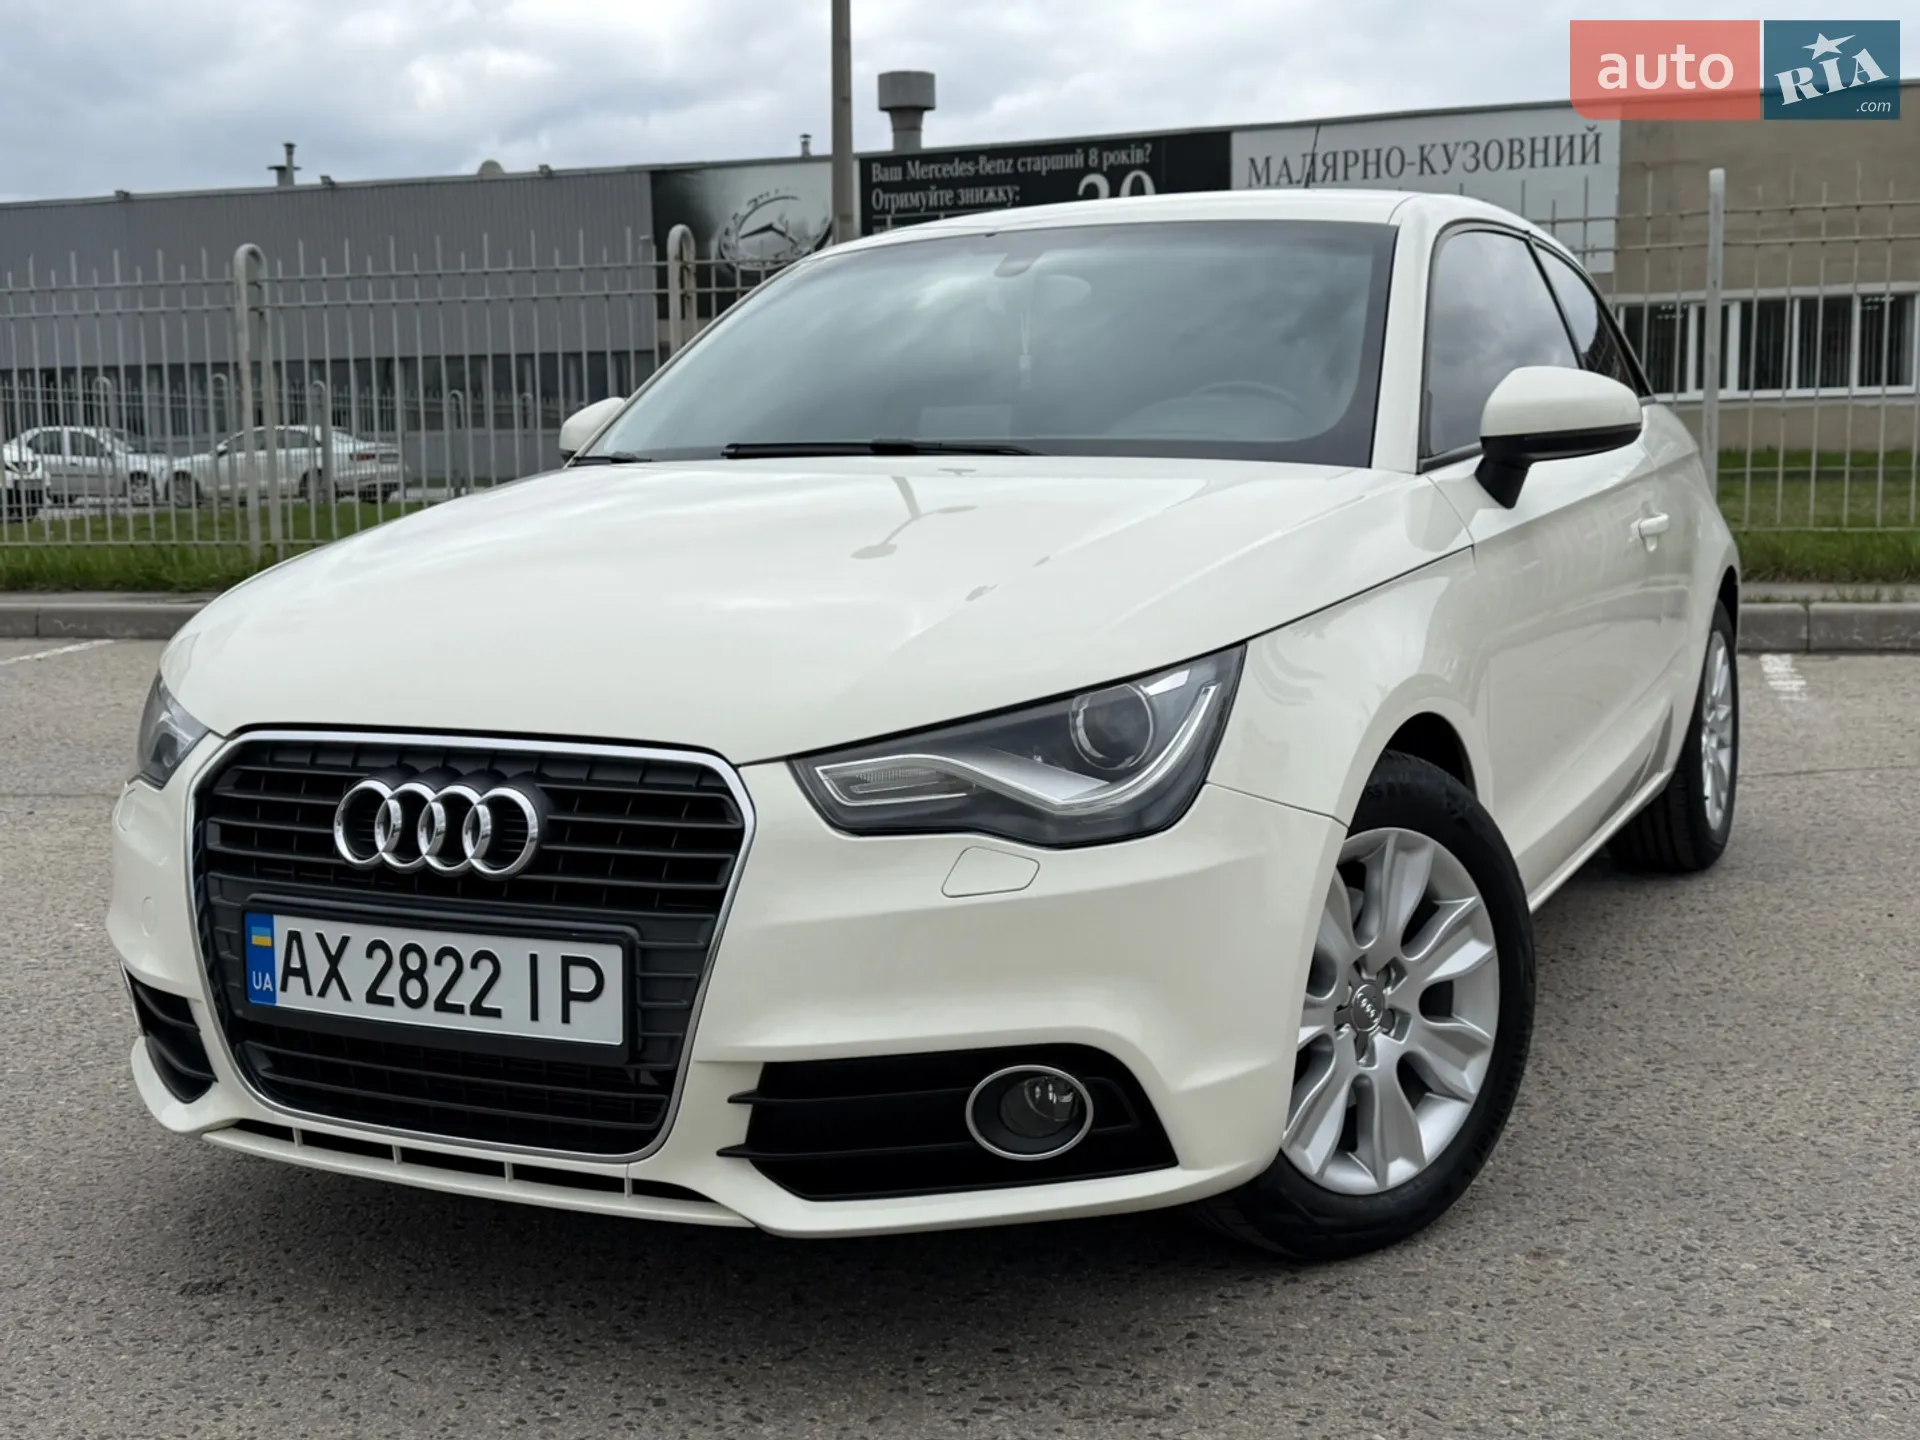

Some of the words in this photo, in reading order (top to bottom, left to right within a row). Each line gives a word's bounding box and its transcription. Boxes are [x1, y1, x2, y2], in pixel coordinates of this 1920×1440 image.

[871, 162, 903, 183] Ваш
[906, 155, 1014, 181] Mercedes-Benz
[1017, 148, 1085, 177] старший
[1088, 147, 1099, 168] 8
[1102, 143, 1153, 172] років?
[1247, 124, 1603, 187] МАЛЯРНО-КУЗОВНИЙ
[871, 185, 954, 215] Отримуйте
[957, 184, 1021, 207] знижку:
[251, 970, 274, 993] UA
[279, 929, 353, 1004] AX
[365, 938, 503, 1019] 2822
[528, 951, 606, 1025] IP
